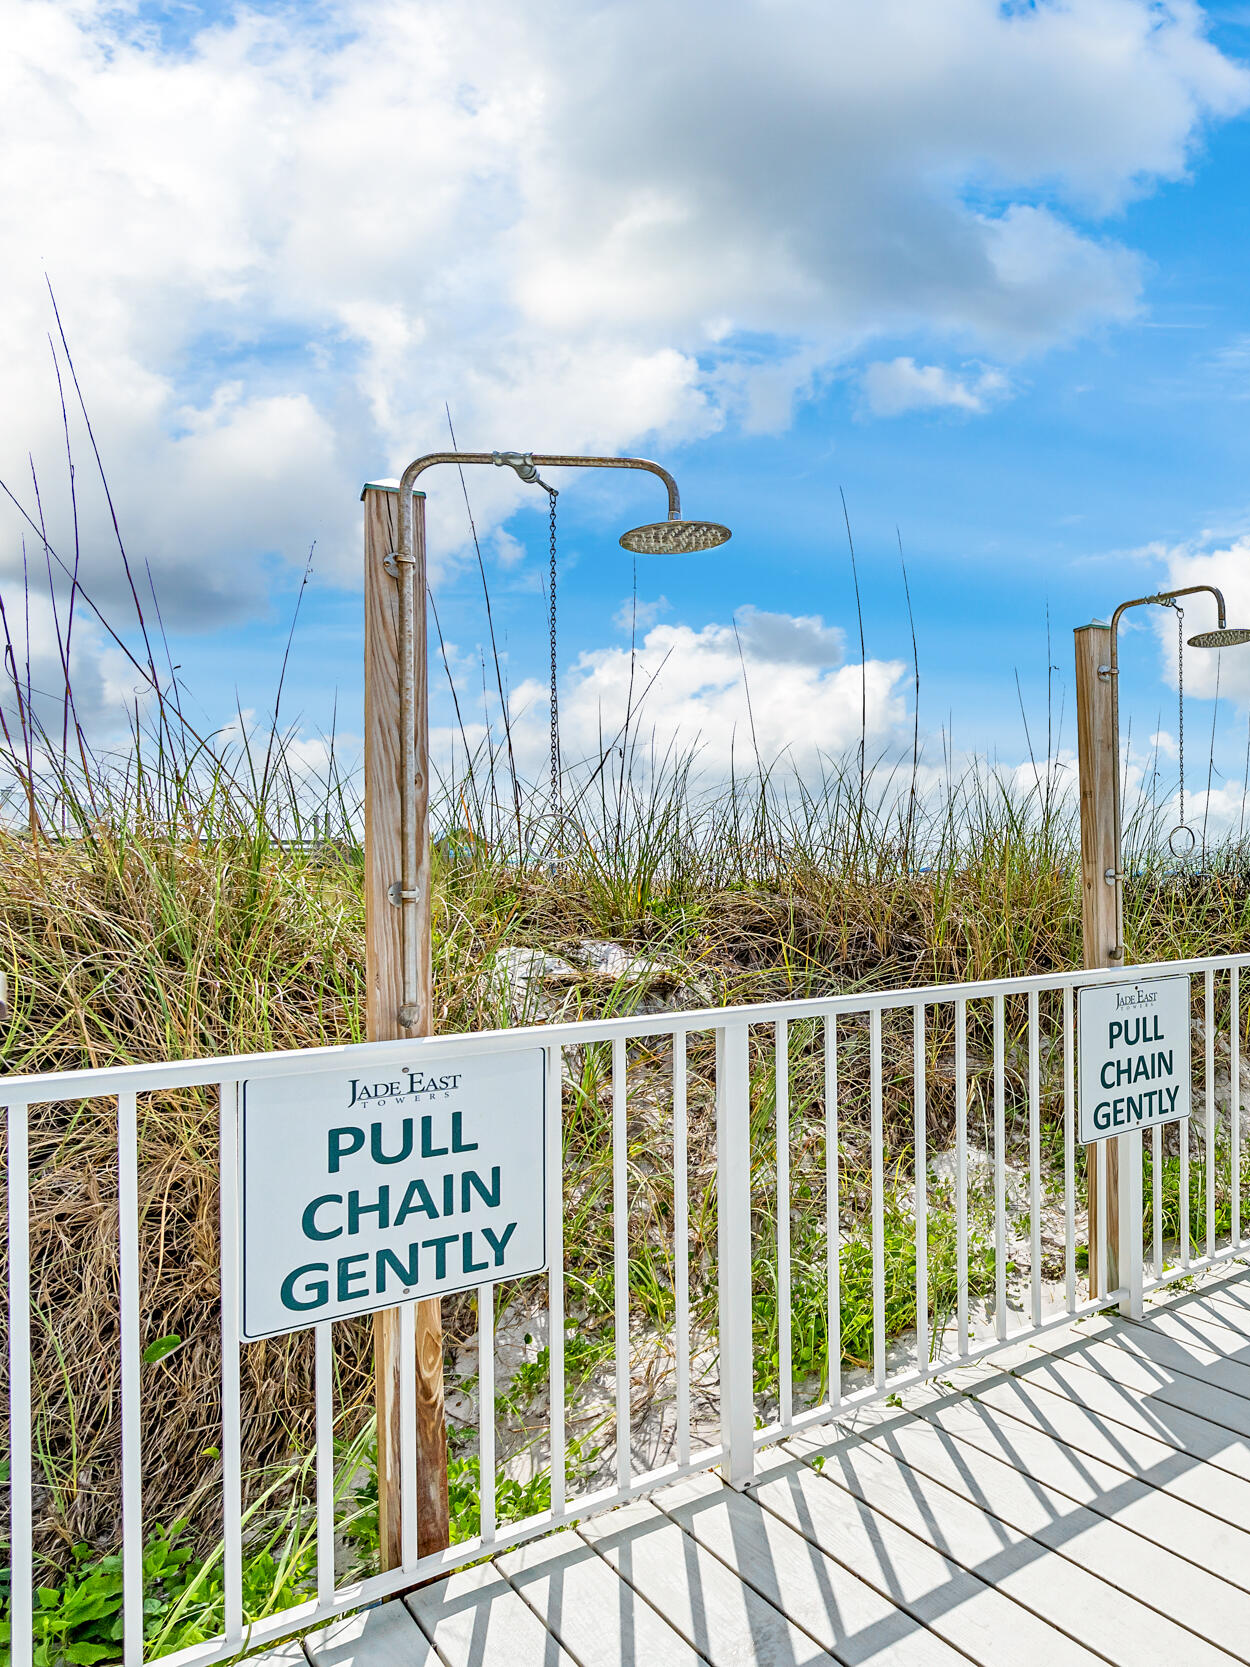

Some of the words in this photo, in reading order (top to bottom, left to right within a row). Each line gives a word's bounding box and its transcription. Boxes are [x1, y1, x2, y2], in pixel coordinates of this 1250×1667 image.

[1116, 993, 1136, 1010] JADE
[1137, 990, 1157, 1003] EAST
[1109, 1014, 1164, 1049] PULL
[1100, 1050, 1173, 1089] CHAIN
[348, 1079, 401, 1108] JADE
[408, 1072, 462, 1093] EAST
[361, 1091, 450, 1109] TOWERS
[1093, 1085, 1180, 1130] GENTLY
[328, 1111, 479, 1173] PULL
[301, 1166, 501, 1241] CHAIN
[280, 1222, 518, 1311] GENTLY
